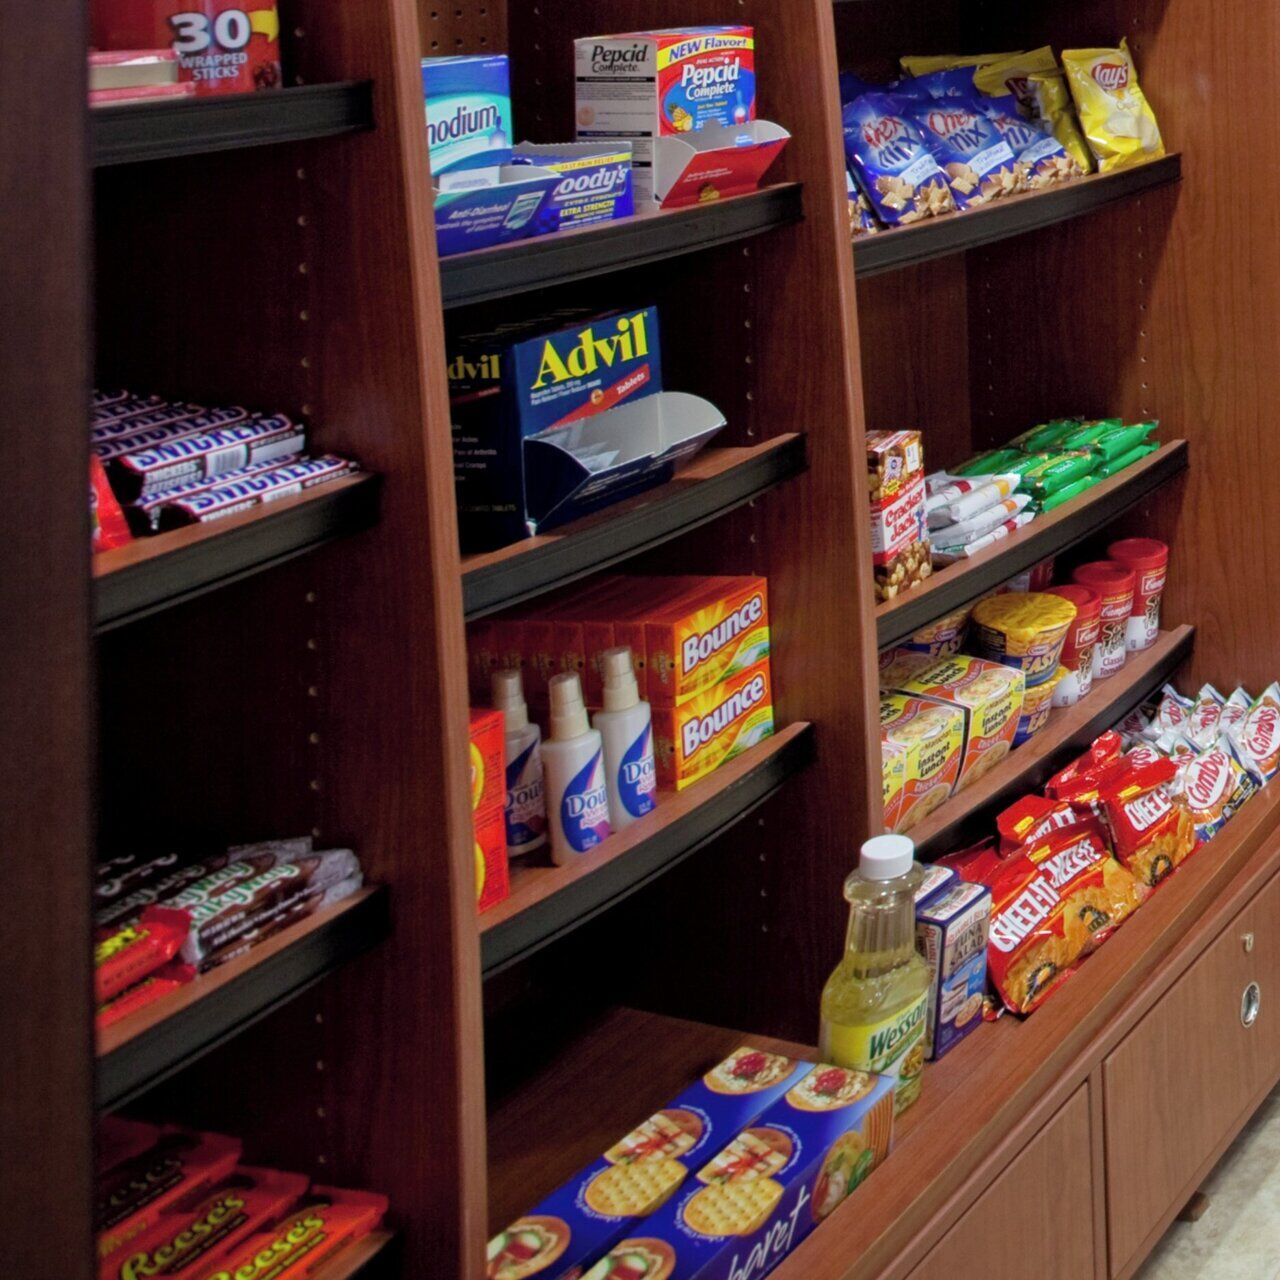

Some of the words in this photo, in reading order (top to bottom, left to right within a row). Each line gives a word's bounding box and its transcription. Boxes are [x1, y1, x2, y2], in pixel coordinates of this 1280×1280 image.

[171, 8, 252, 52] 30
[591, 43, 648, 65] Pepcid
[669, 38, 701, 62] NEW
[703, 37, 747, 49] Flavor!
[192, 65, 240, 81] STICKS
[591, 61, 639, 75] Complete
[681, 57, 741, 88] Pepcid
[1094, 61, 1129, 91] Lay's
[685, 83, 736, 102] Complete
[530, 312, 648, 391] Advil
[448, 353, 500, 381] dvil
[617, 372, 646, 395] Tablets
[137, 413, 289, 469] SNICKERS
[197, 455, 347, 511] SNICKERS
[884, 487, 924, 528] Cracker
[890, 514, 916, 543] Jack
[683, 595, 762, 674] Bounce
[684, 676, 766, 758] Bounce
[1247, 708, 1278, 756] Combos
[917, 741, 951, 771] Instant
[920, 754, 947, 778] Lunch
[1187, 751, 1227, 804] Combos
[988, 875, 1061, 954] CHEEZ-IT
